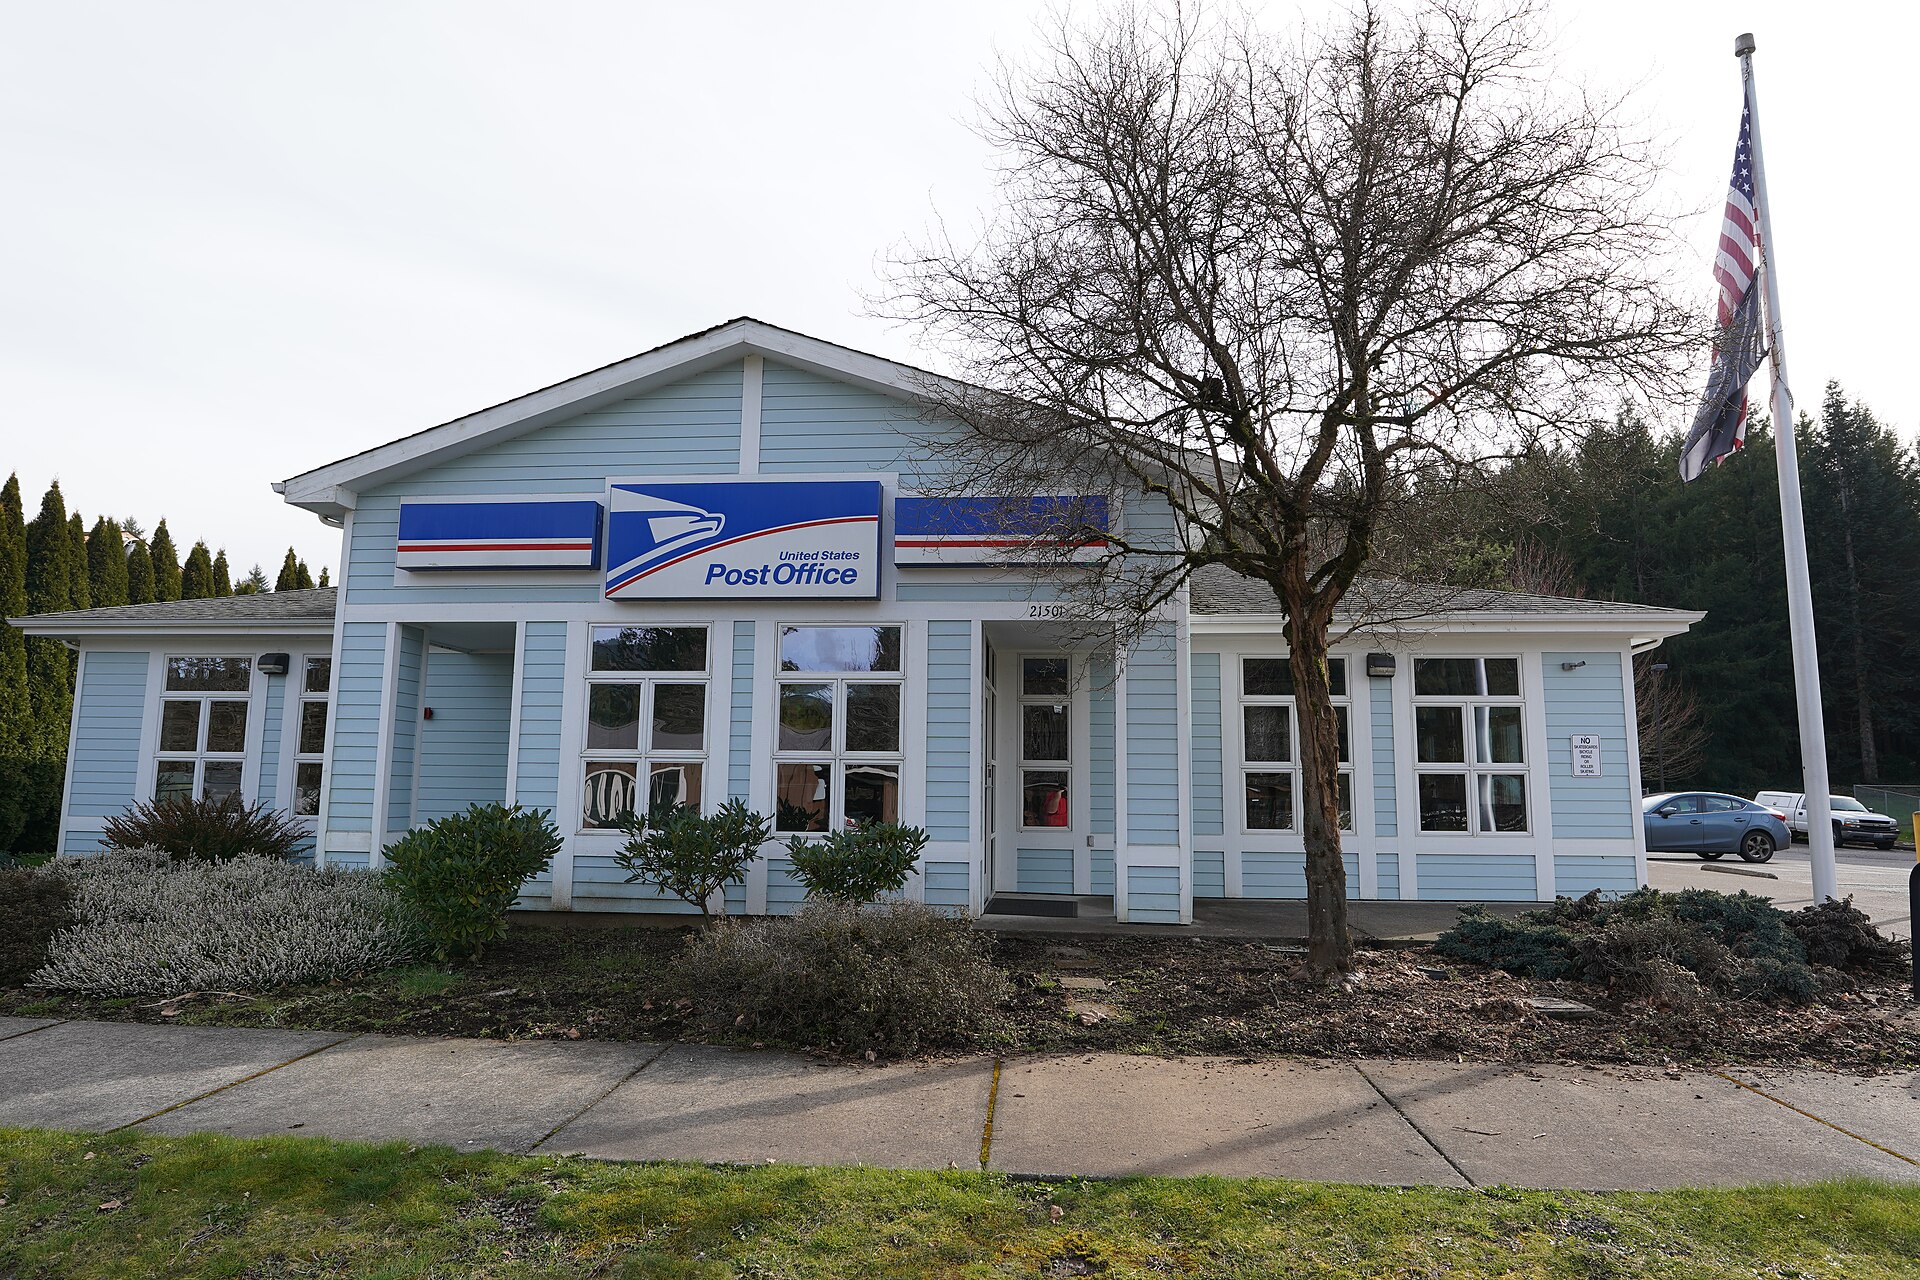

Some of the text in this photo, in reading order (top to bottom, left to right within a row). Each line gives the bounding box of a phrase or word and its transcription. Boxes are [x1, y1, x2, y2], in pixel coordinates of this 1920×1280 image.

[779, 550, 860, 561] United States
[704, 562, 858, 586] Post Office
